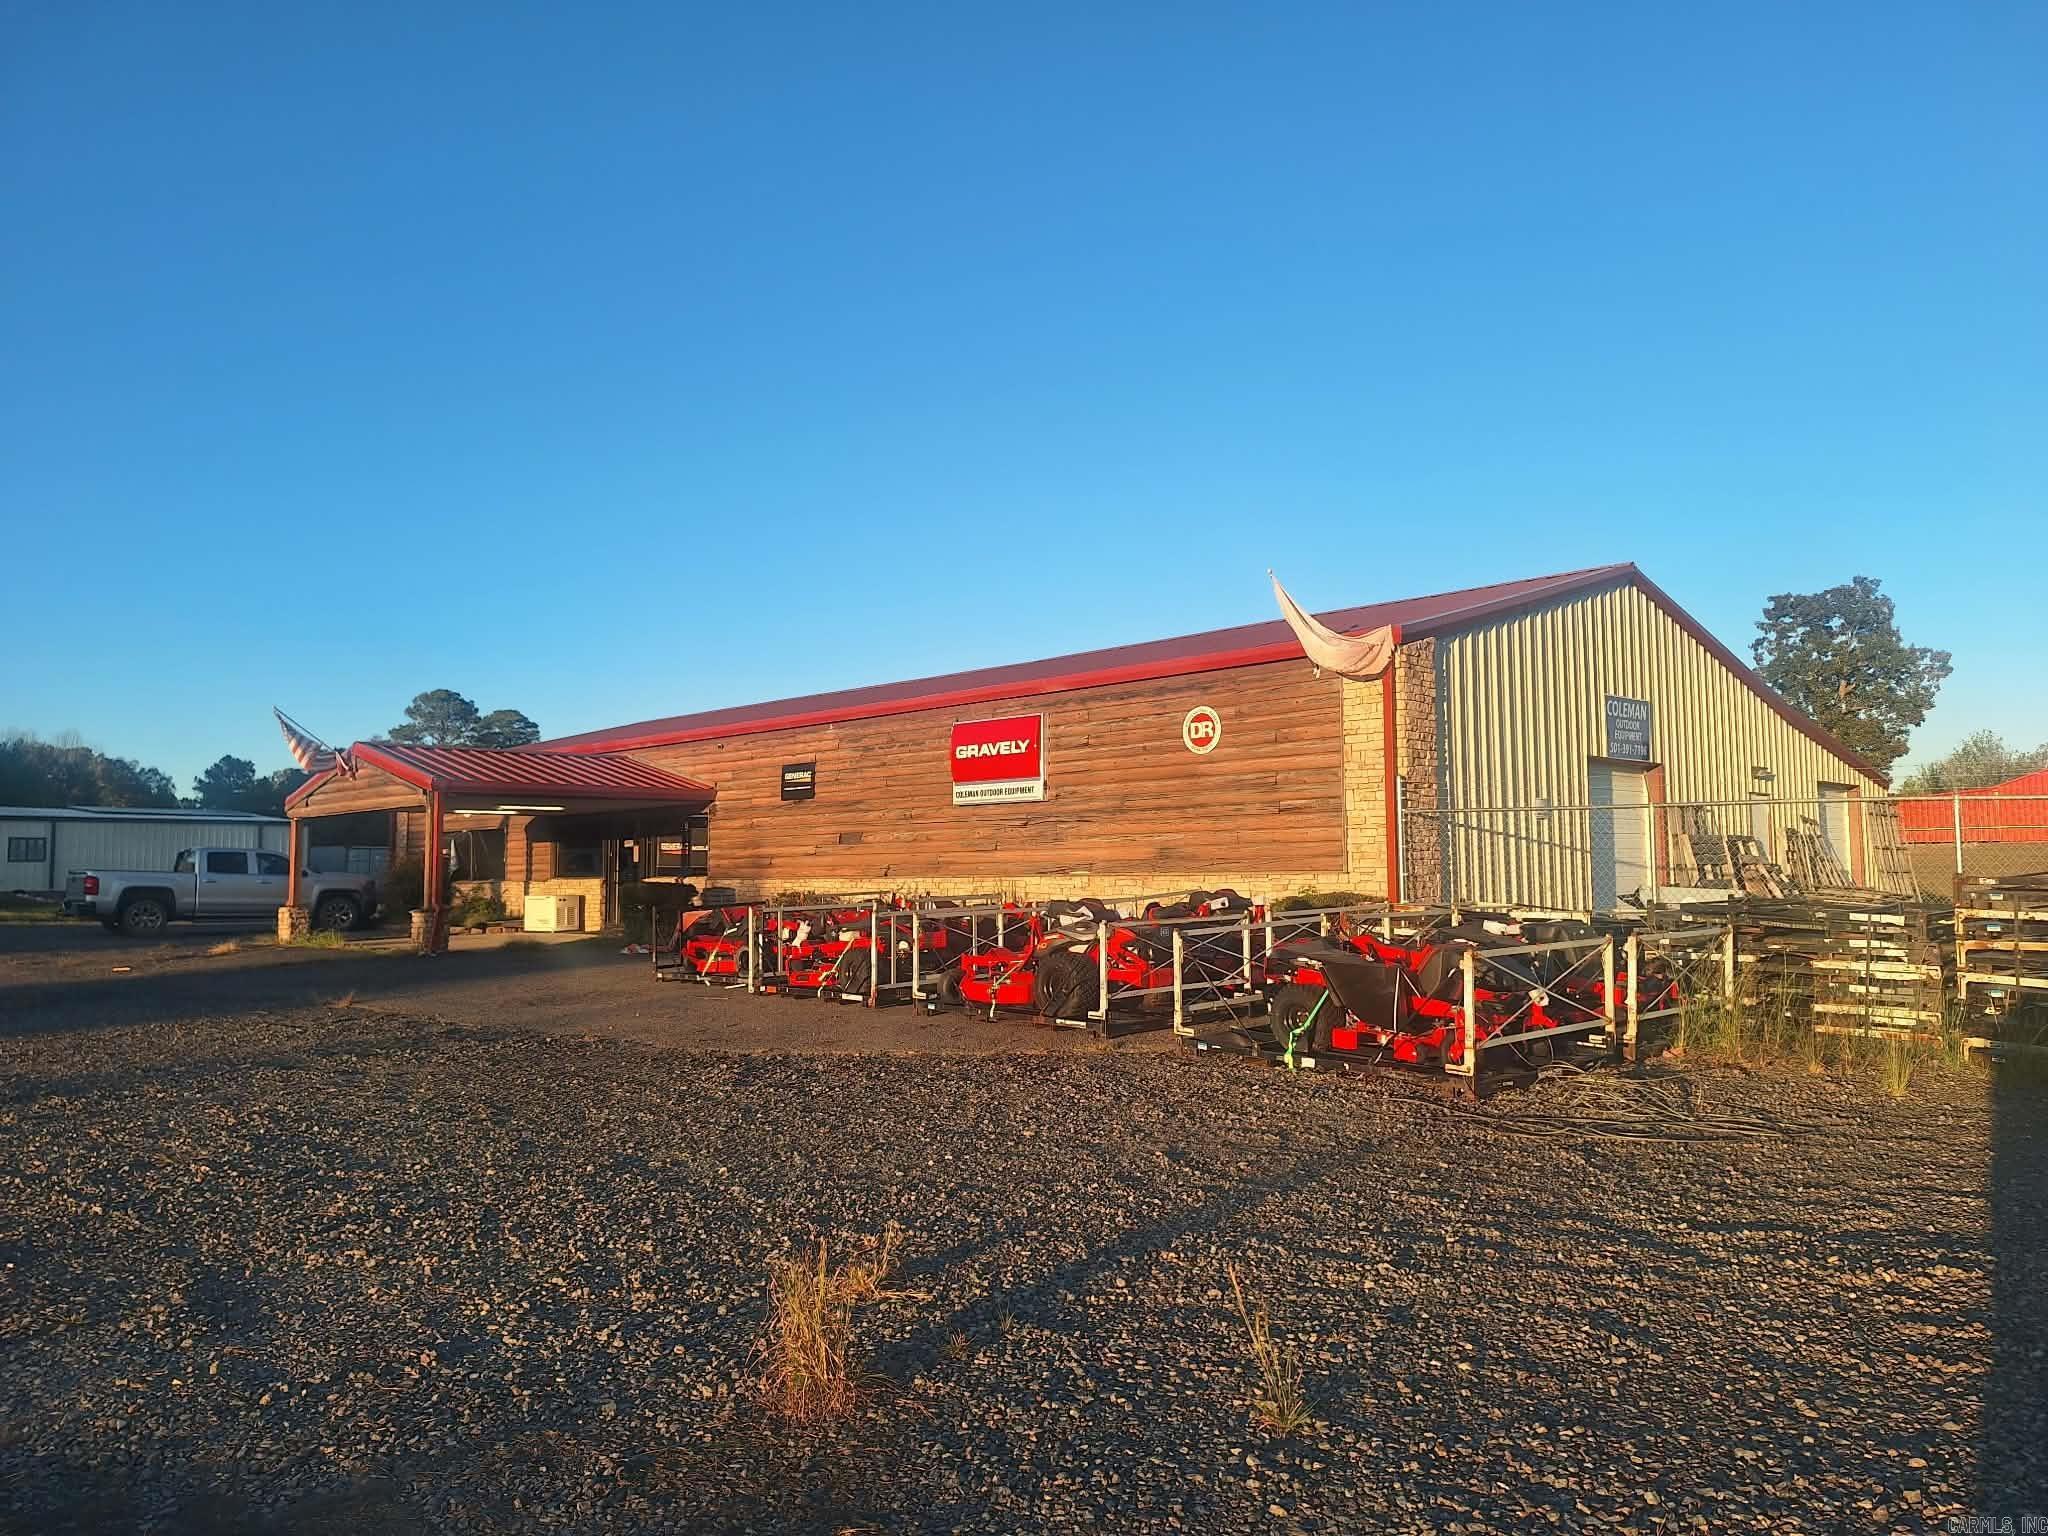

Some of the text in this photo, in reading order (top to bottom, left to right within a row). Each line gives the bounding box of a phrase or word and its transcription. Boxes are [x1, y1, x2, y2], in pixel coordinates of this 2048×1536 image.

[1607, 701, 1647, 720] COLEMAN
[1190, 720, 1213, 738] DR
[1615, 719, 1640, 730] OUTDOOR
[1614, 729, 1642, 741] EQUIPMENT
[955, 739, 1030, 759] GRAVELY
[955, 786, 1034, 799] COLEMAN OUTDOOR EQUIPMENT
